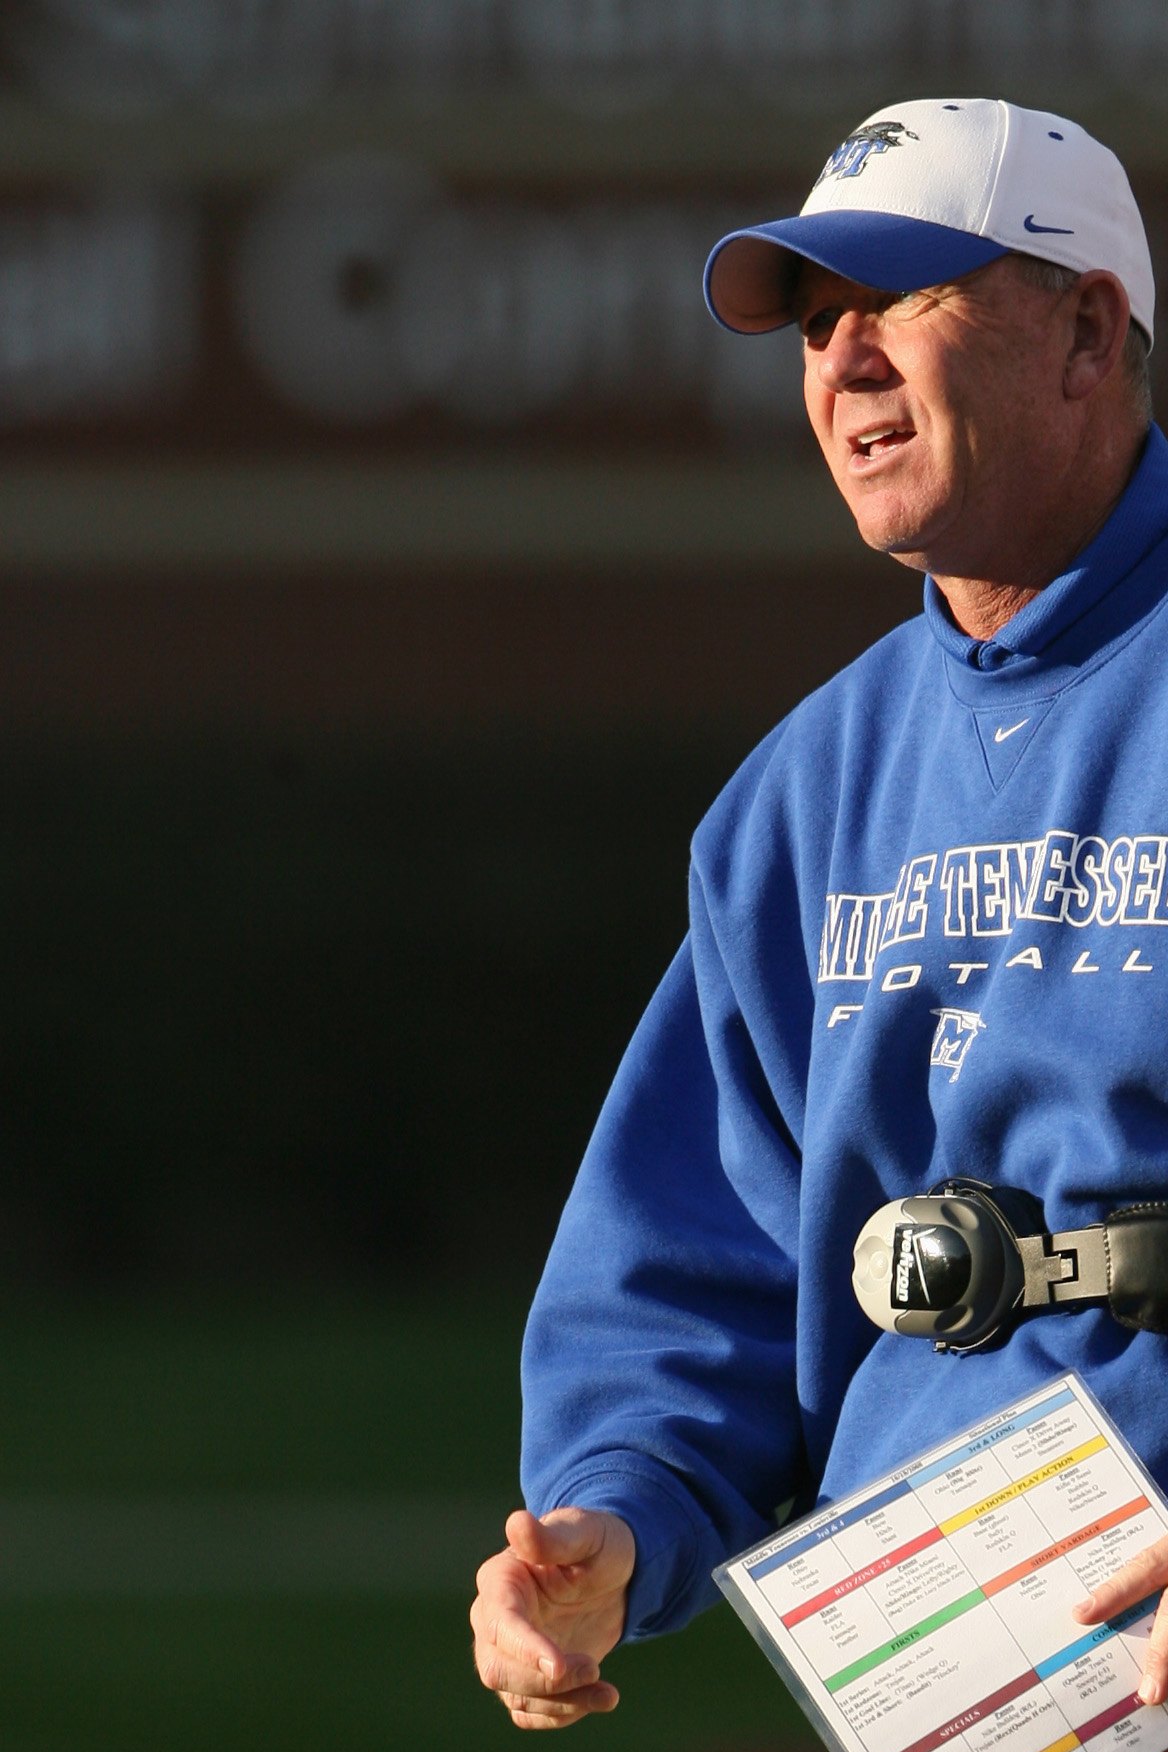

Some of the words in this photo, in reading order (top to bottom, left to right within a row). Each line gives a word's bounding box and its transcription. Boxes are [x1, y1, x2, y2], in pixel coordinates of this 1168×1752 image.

[897, 1229, 914, 1302] verizon
[967, 1442, 981, 1453] 3rd
[989, 1423, 1015, 1441] LONG
[984, 1489, 1013, 1509] DOWN
[1017, 1474, 1041, 1491] PLAY
[1040, 1455, 1074, 1478] ACTION
[1030, 1548, 1059, 1567] SHORT
[1060, 1523, 1100, 1550] YARDAGE
[833, 1580, 854, 1595] RED
[852, 1567, 876, 1584] ZONE
[1127, 1604, 1146, 1619] OUT
[889, 1629, 920, 1651] FIRSTS
[938, 1709, 981, 1738] SPECIALS
